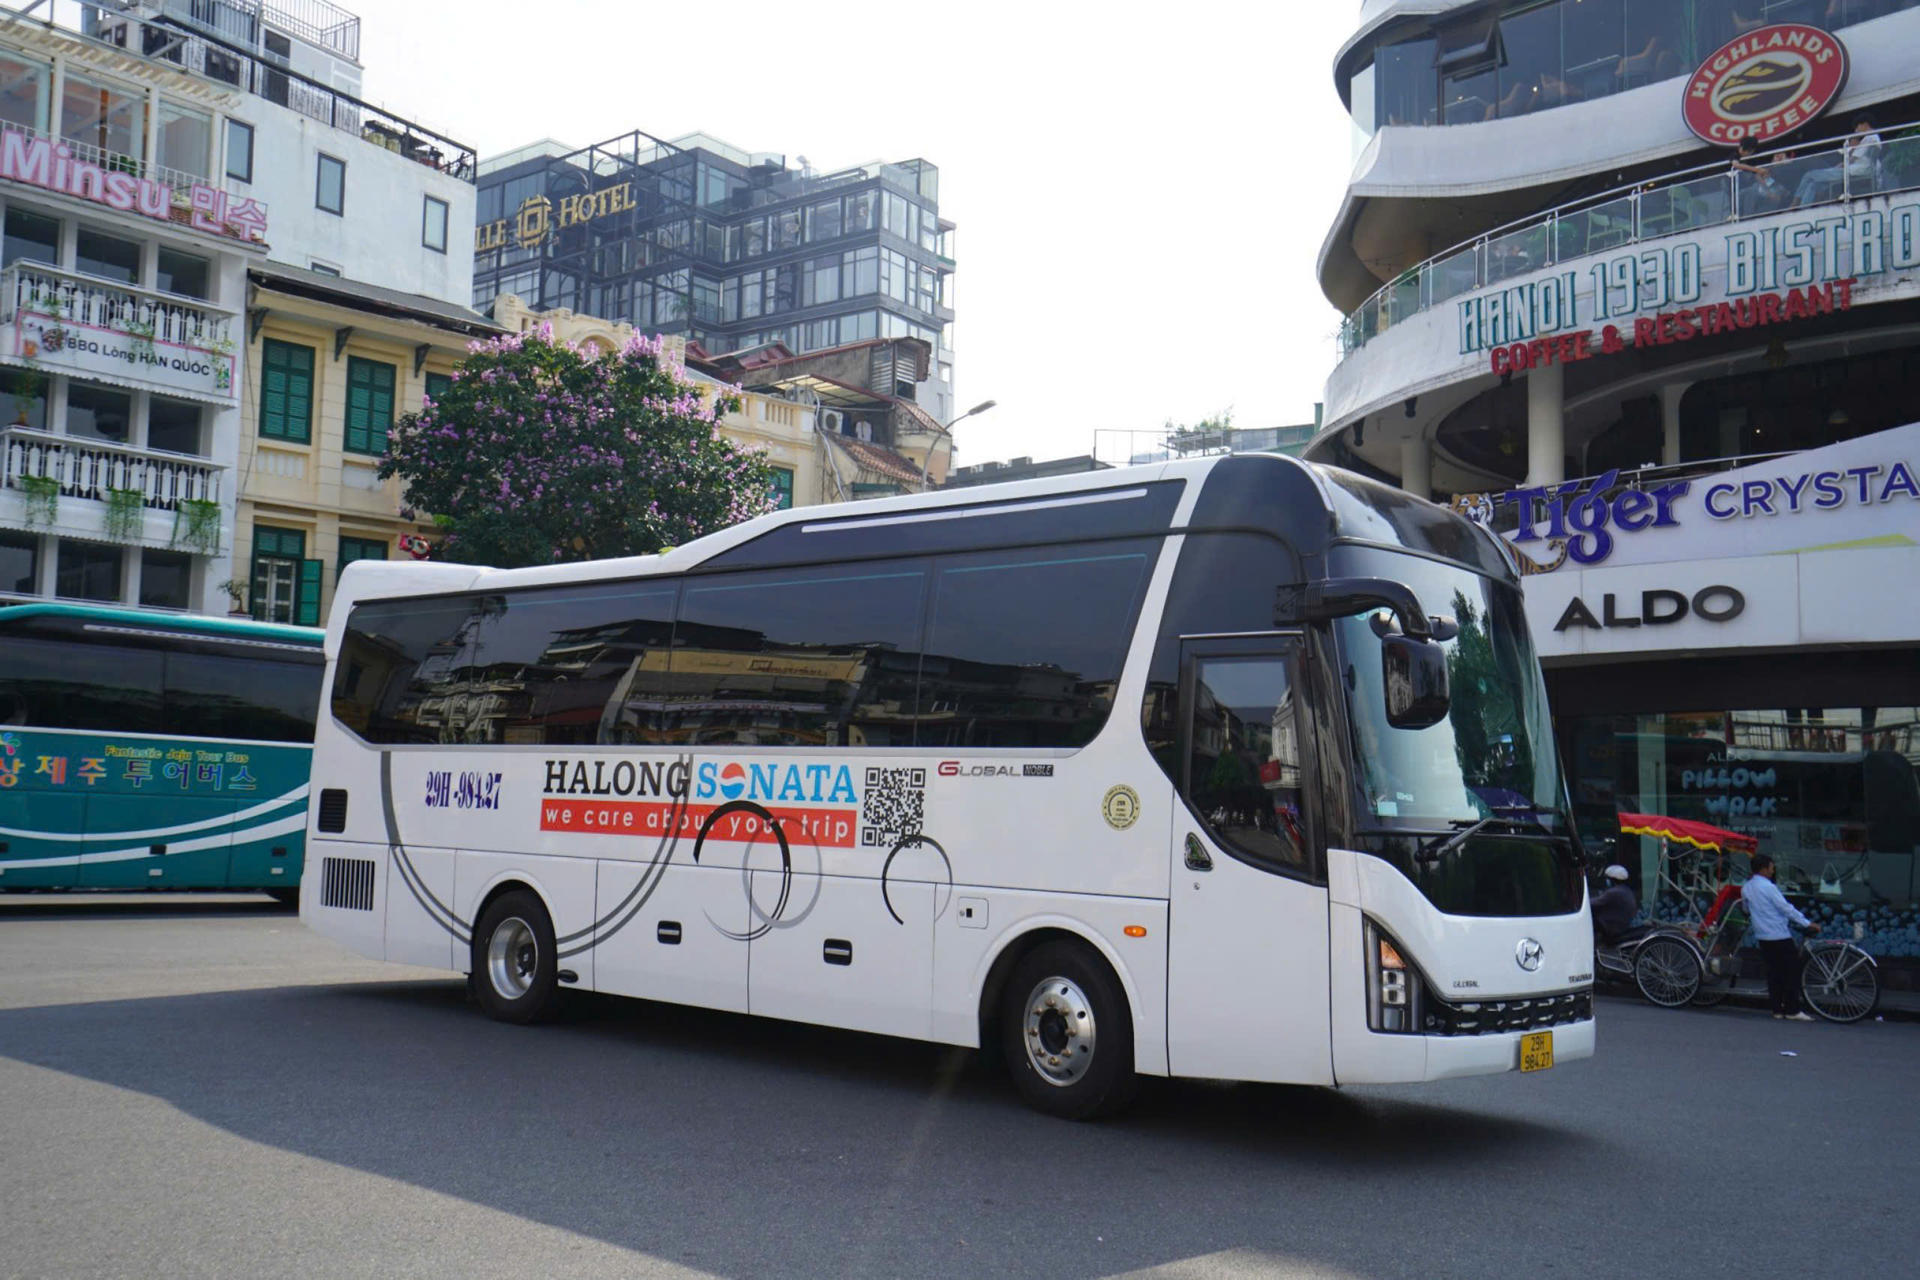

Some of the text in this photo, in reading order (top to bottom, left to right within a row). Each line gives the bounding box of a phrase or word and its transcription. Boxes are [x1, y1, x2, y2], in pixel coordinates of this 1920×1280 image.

[1691, 31, 1834, 99] HIGHLANDS
[1709, 95, 1818, 141] COFFEE
[1, 130, 267, 242] Minsu 민수
[558, 182, 637, 229] HOTEL
[1459, 203, 1920, 355] HANOI 1930 BISTRO
[67, 337, 98, 354] BBQ
[1490, 278, 1858, 375] COFFEE & RESTAURANT
[1504, 460, 1920, 565] Tiger CRYSTA
[1553, 585, 1746, 632] ALDO
[543, 760, 857, 803] HALONG SONATA
[938, 761, 1021, 777] GLOBAL
[1682, 768, 1776, 790] PILLOW
[545, 807, 572, 824] we
[584, 810, 633, 826] care
[730, 814, 786, 837] your
[802, 815, 848, 843] trip
